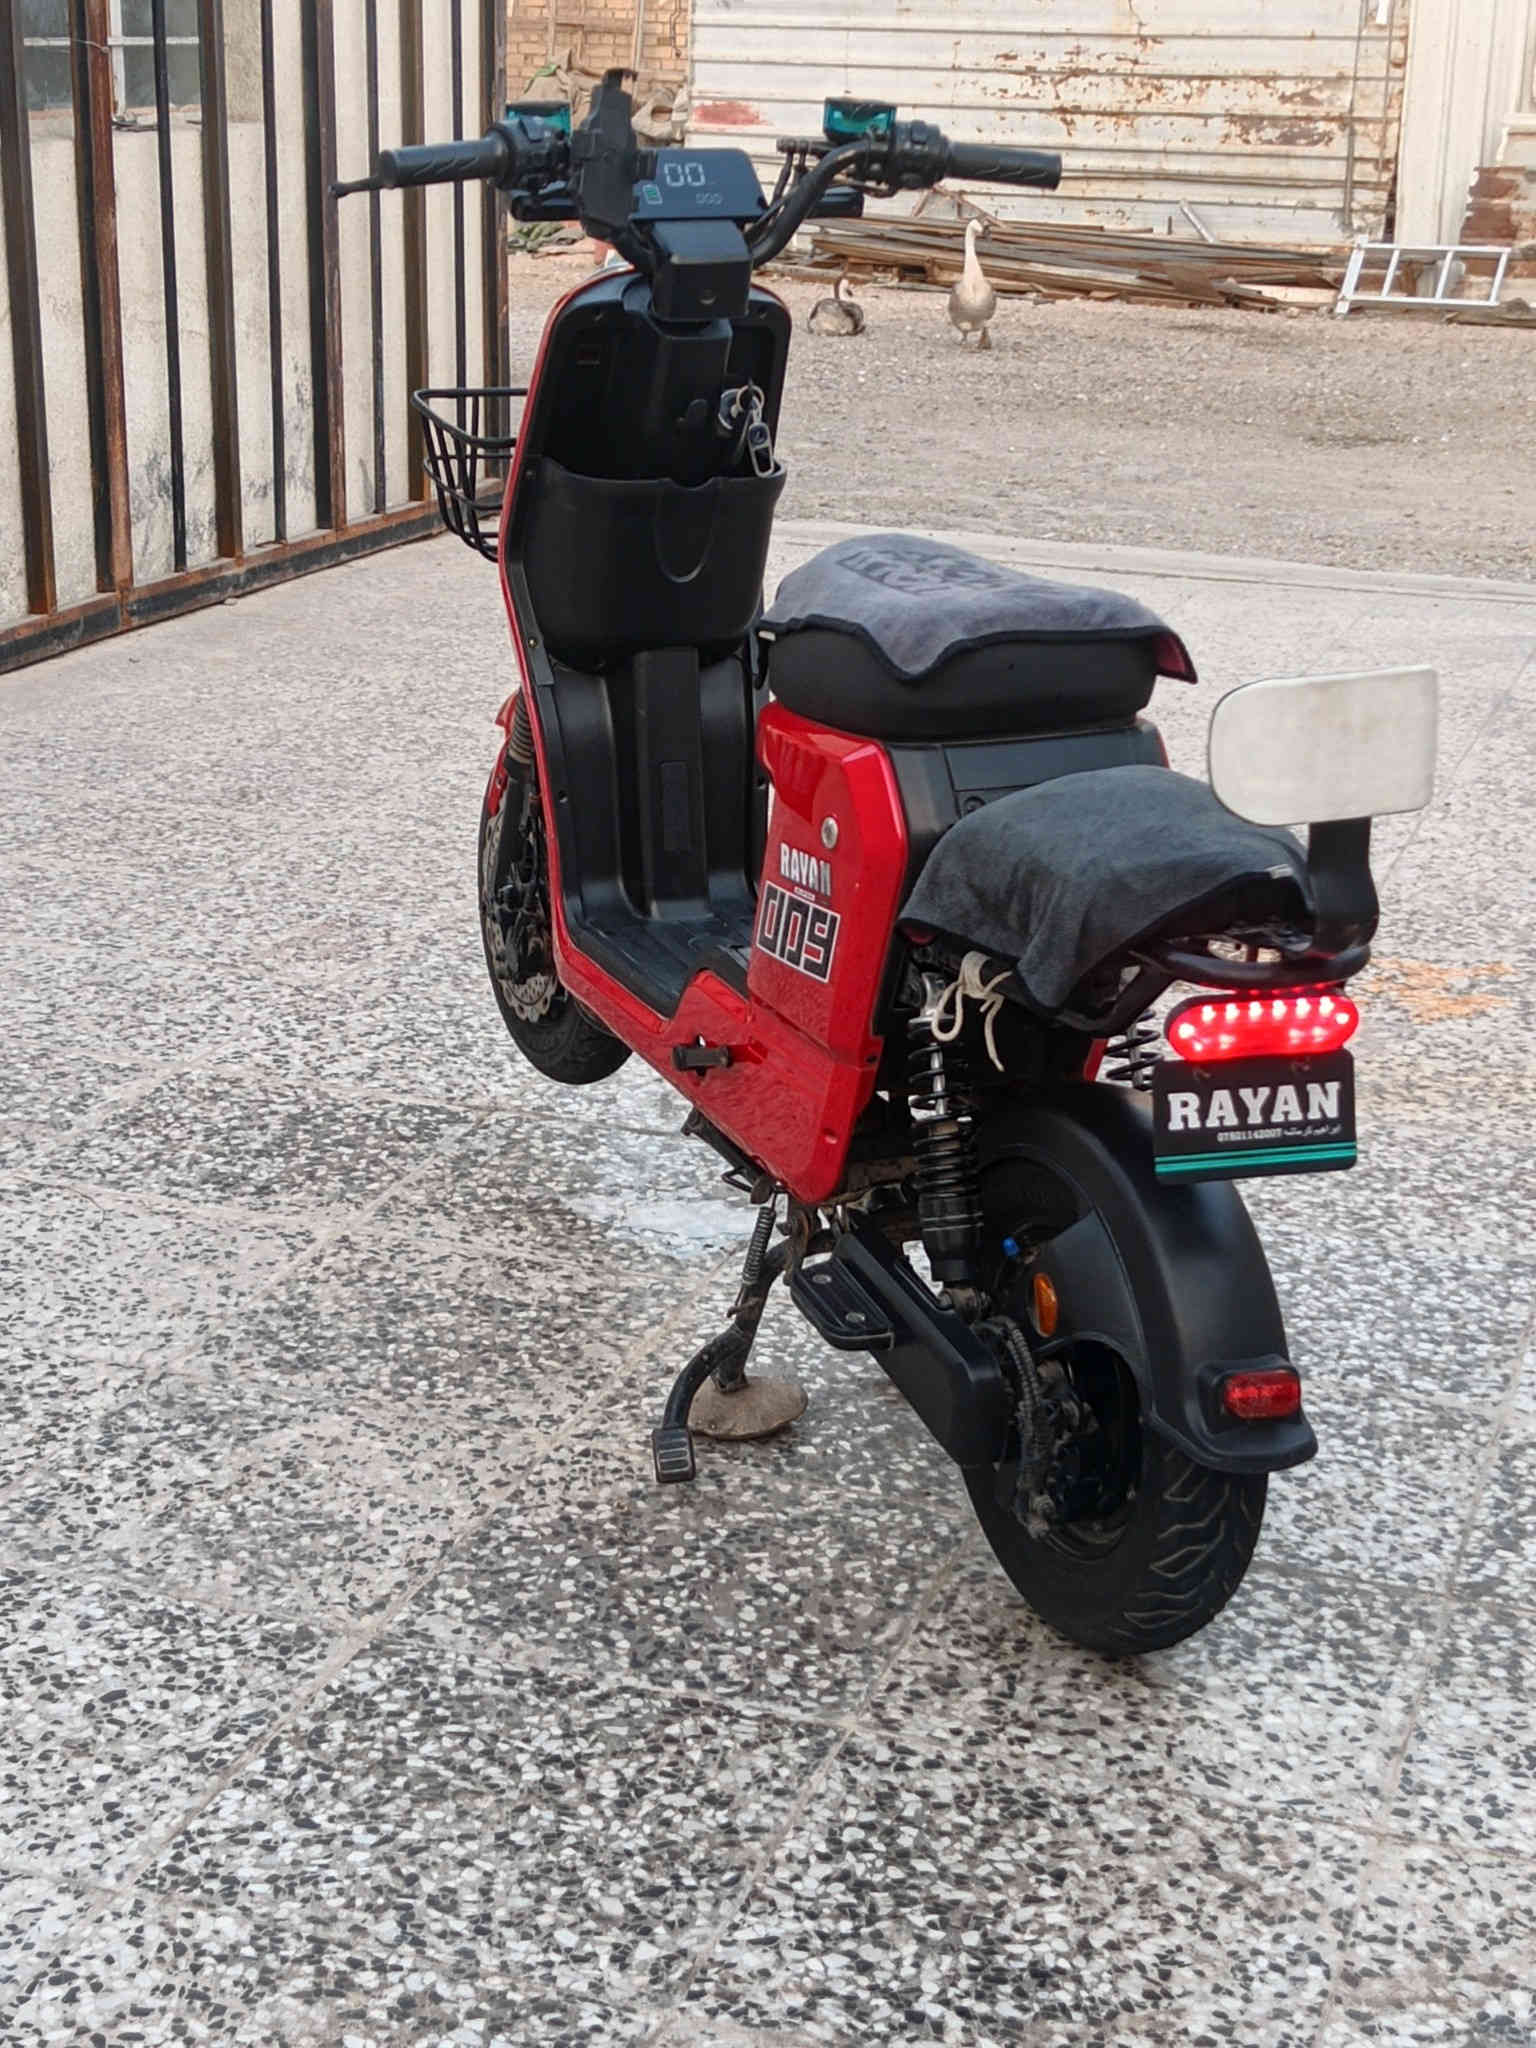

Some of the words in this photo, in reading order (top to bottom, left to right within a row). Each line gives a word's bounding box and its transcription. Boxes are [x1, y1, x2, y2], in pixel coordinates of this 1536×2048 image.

[664, 163, 705, 186] 00
[780, 842, 831, 896] RAYAN
[1167, 1081, 1341, 1131] RAYAN
